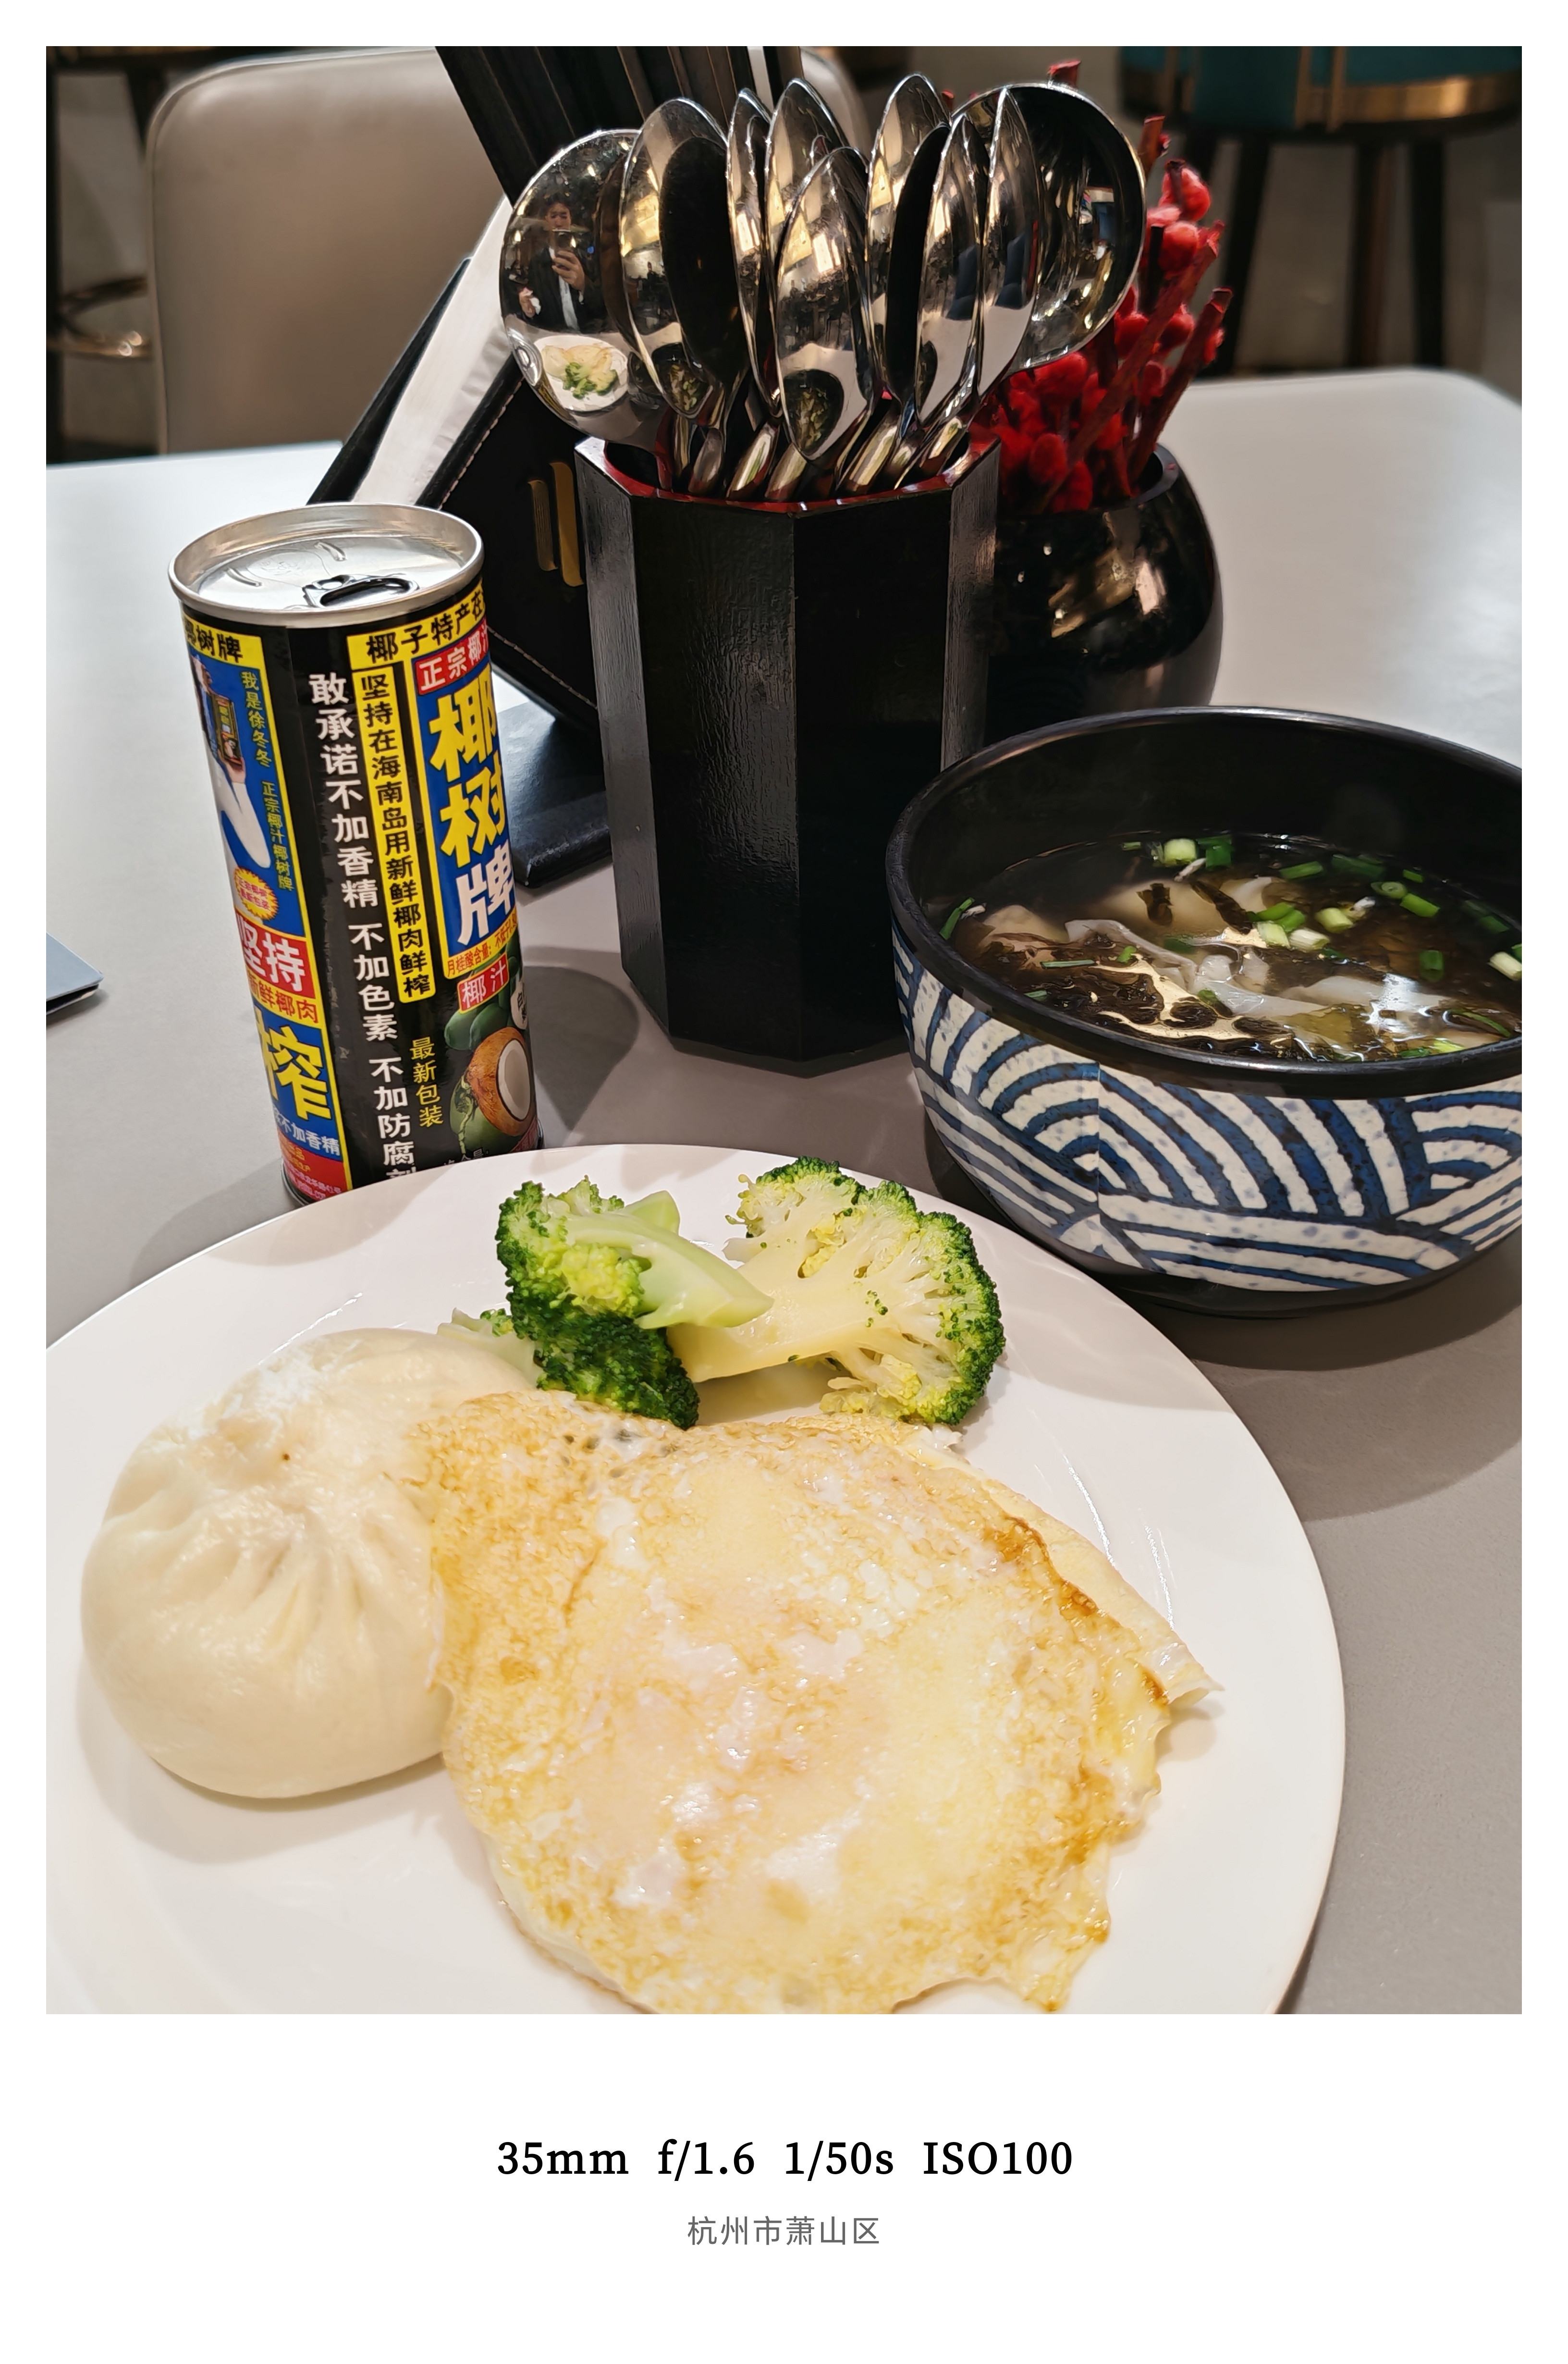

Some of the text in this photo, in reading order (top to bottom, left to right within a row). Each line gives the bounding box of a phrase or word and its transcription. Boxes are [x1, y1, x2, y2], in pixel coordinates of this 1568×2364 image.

[241, 671, 272, 768] 我是徐冬冬
[360, 674, 432, 998] 坚持在海南岛用新鲜椰肉鲜榨
[429, 663, 515, 945] 椰树牌
[308, 672, 379, 908] 敢承诺不加香精
[348, 922, 398, 1042] 不加色素
[236, 912, 306, 992] 坚持
[462, 960, 506, 1008] 椰汁
[409, 1037, 443, 1127] 最新包装
